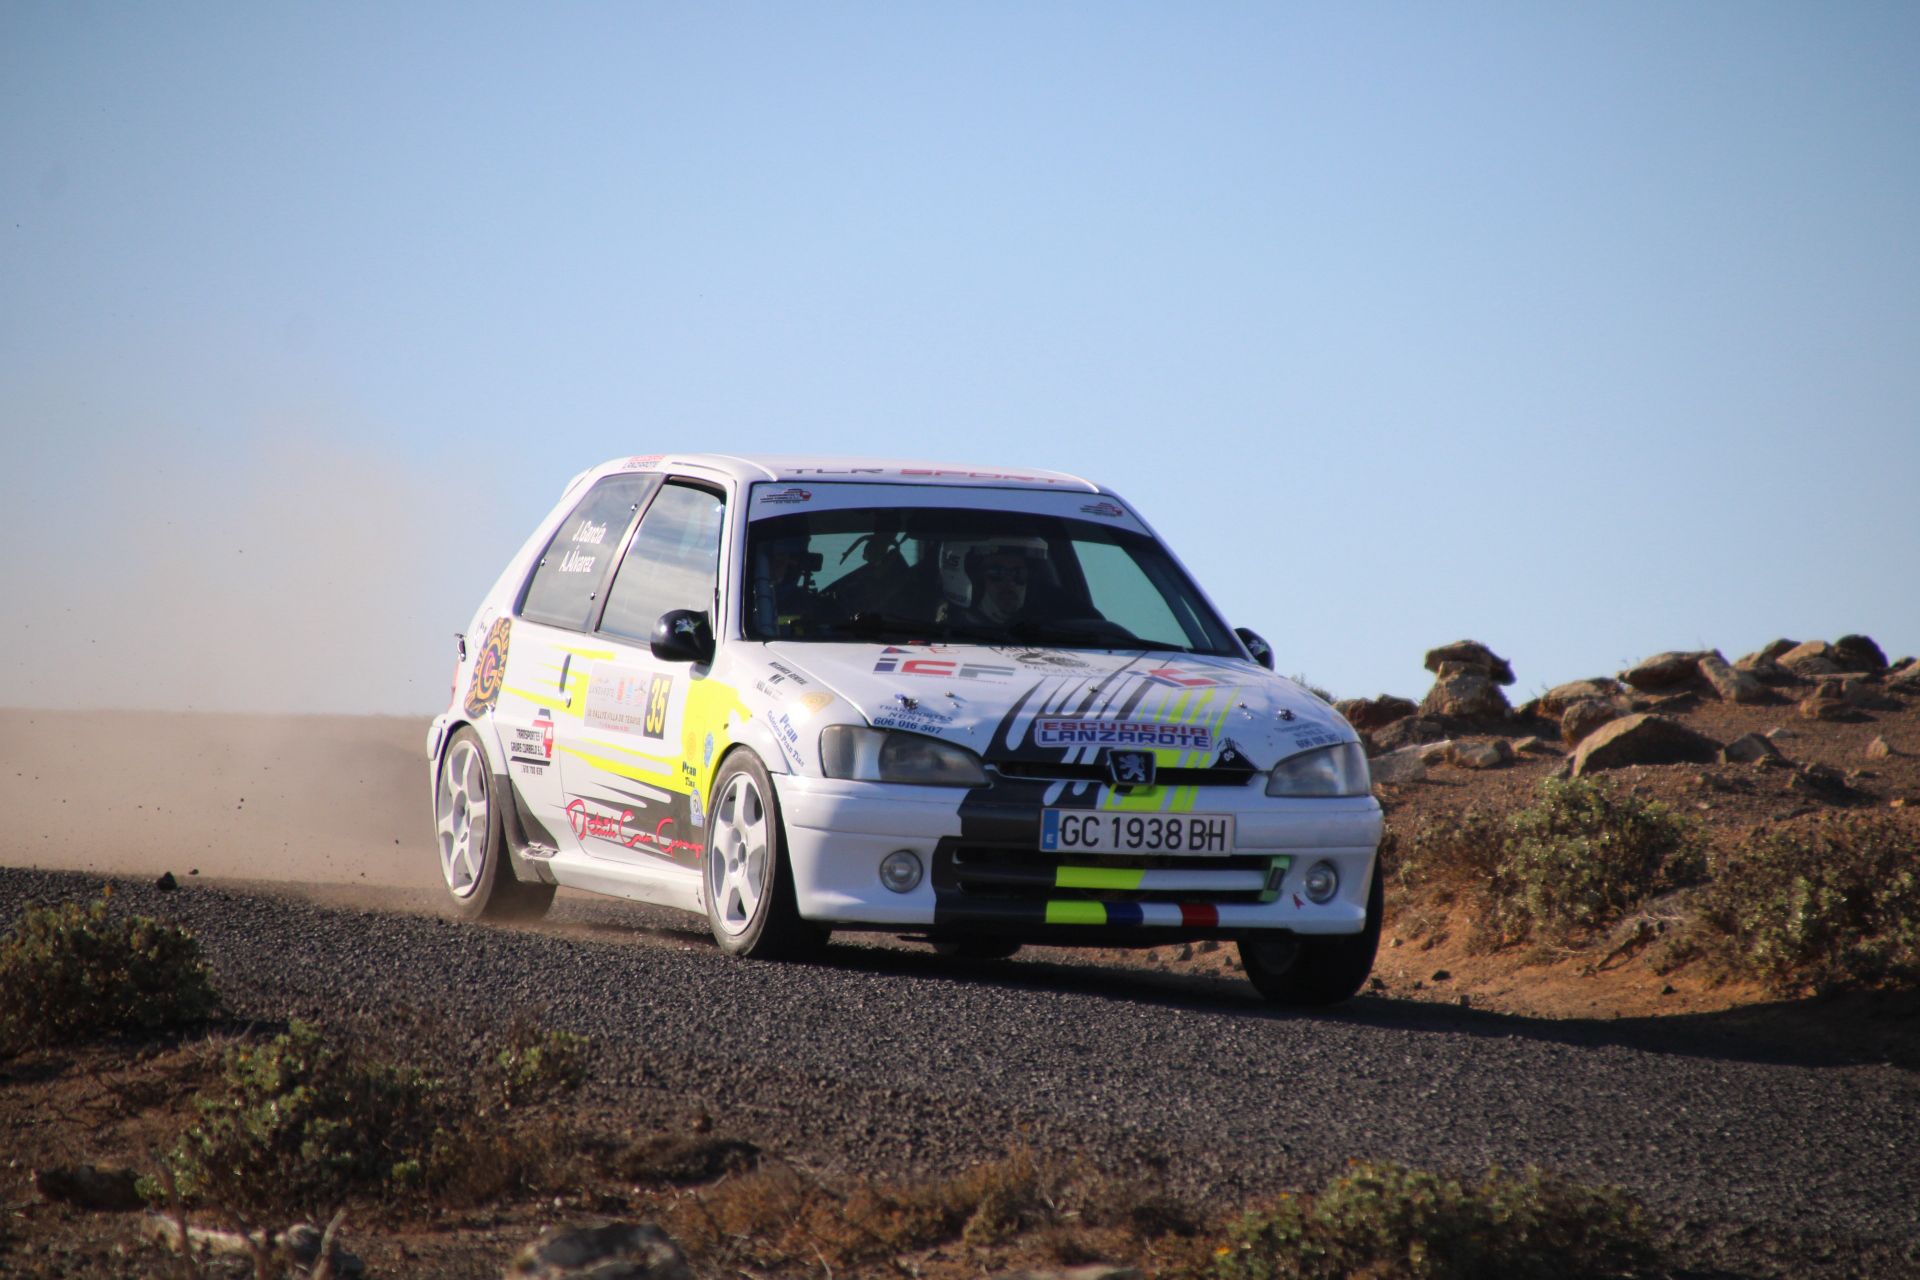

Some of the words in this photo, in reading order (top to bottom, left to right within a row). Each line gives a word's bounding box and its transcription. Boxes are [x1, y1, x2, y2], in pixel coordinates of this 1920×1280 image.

[646, 677, 671, 734] 35
[873, 717, 895, 726] 606
[898, 720, 918, 730] 016
[920, 724, 944, 734] 507
[1041, 731, 1209, 748] LANZAROTE
[1046, 834, 1054, 844] E
[1061, 815, 1100, 847] GC
[1111, 816, 1183, 850] 1938
[1189, 819, 1226, 851] BH
